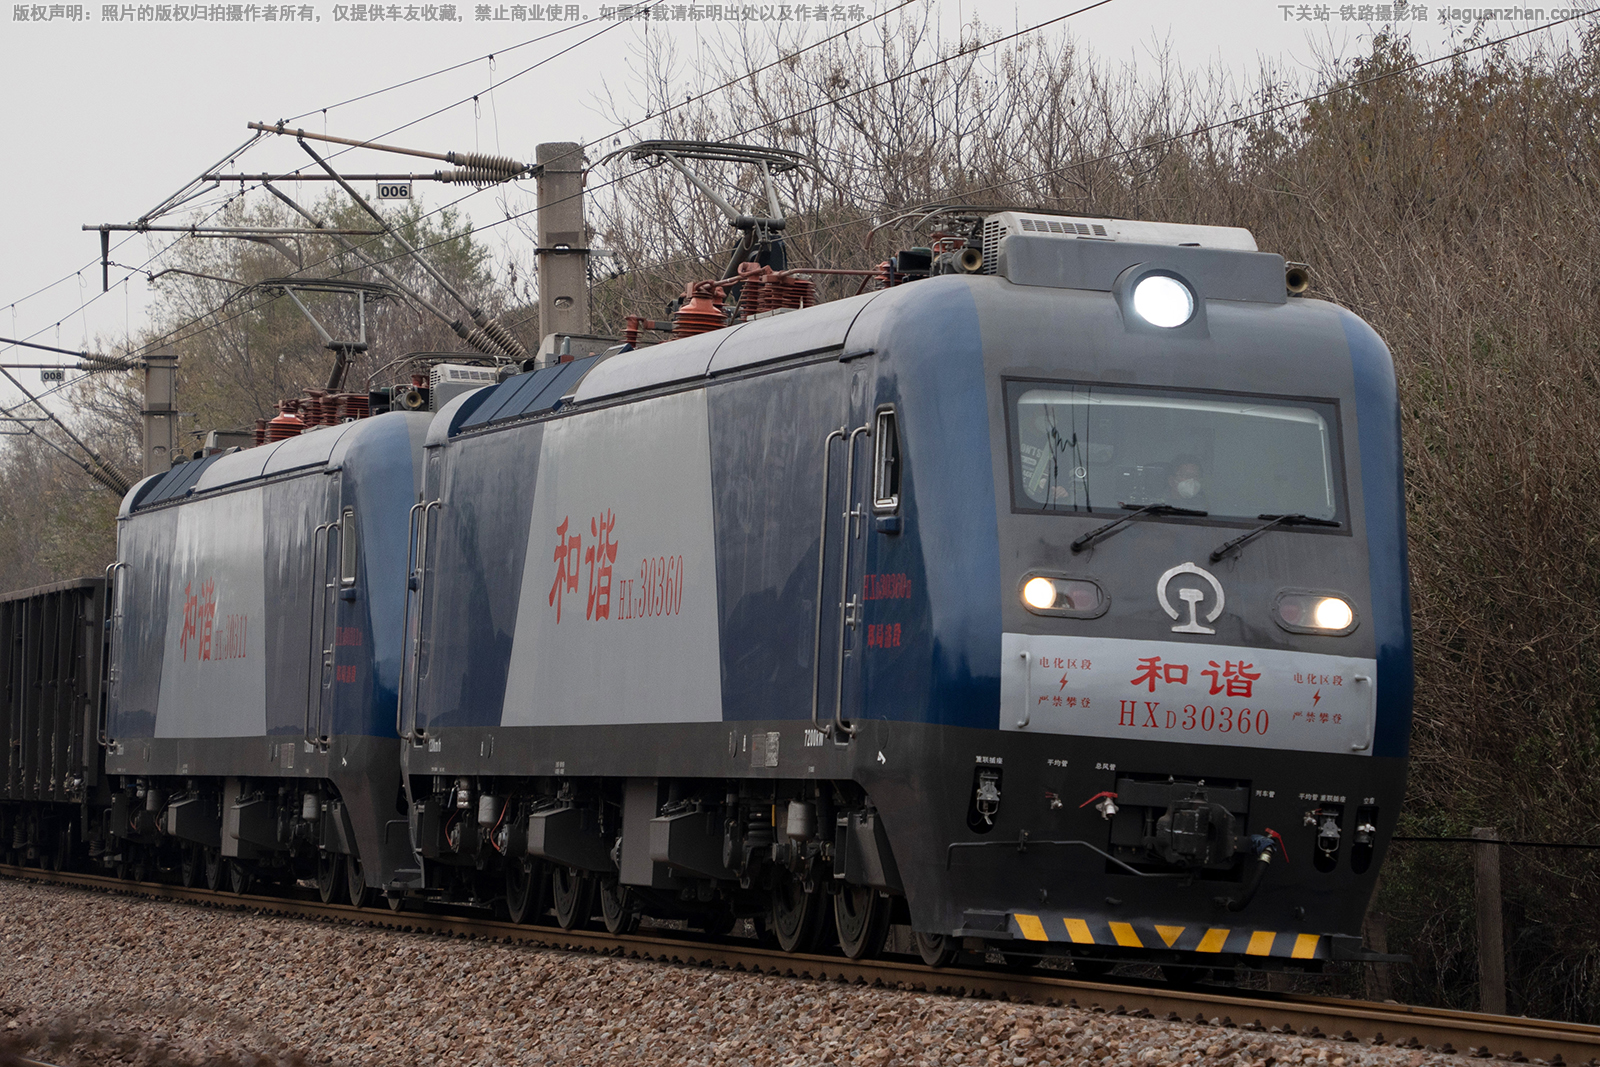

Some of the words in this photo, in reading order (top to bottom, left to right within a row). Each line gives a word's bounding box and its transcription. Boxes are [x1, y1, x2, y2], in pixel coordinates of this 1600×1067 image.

[380, 185, 408, 197] 006
[43, 372, 62, 380] 008
[549, 507, 619, 625] 和谐
[180, 575, 216, 662] 和谐
[1039, 656, 1092, 670] 电化区段
[1130, 655, 1262, 698] 和谐
[1293, 672, 1343, 686] 电化区段
[1038, 695, 1091, 708] 严禁攀登
[1118, 699, 1270, 736] HXD30360
[1292, 711, 1342, 725] 严禁攀登
[1047, 758, 1069, 767] 平均管
[1095, 762, 1117, 771] 总风管
[1255, 789, 1276, 799] 列车管
[1298, 792, 1319, 801] 平均管
